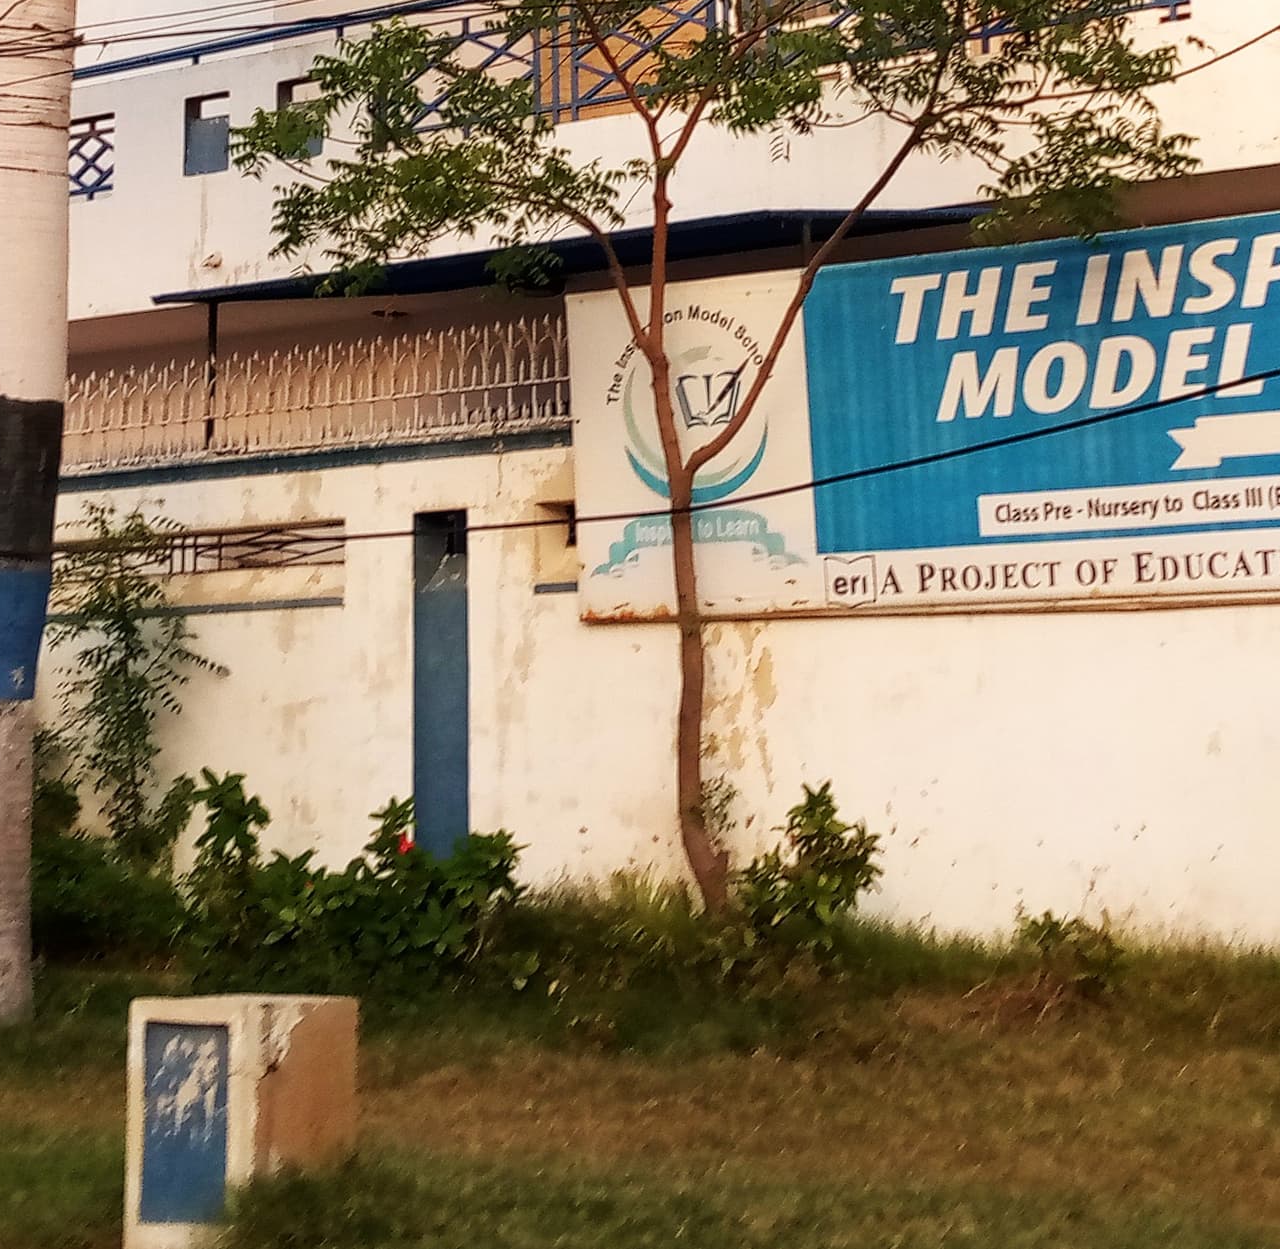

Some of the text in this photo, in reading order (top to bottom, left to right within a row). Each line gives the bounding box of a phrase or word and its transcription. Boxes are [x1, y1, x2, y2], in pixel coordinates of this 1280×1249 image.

[687, 303, 736, 332] Model
[890, 260, 1058, 345] THE
[936, 323, 1265, 423] MODEL
[994, 501, 1039, 524] Class
[1043, 500, 1073, 522] Pre
[1086, 495, 1160, 521] Nursery
[1164, 494, 1184, 514] to
[1192, 488, 1241, 512] Class
[1245, 486, 1263, 509] III
[716, 515, 759, 538] Learn
[880, 563, 904, 595] A
[916, 558, 1063, 594] PROJECT
[1074, 557, 1120, 587] OF
